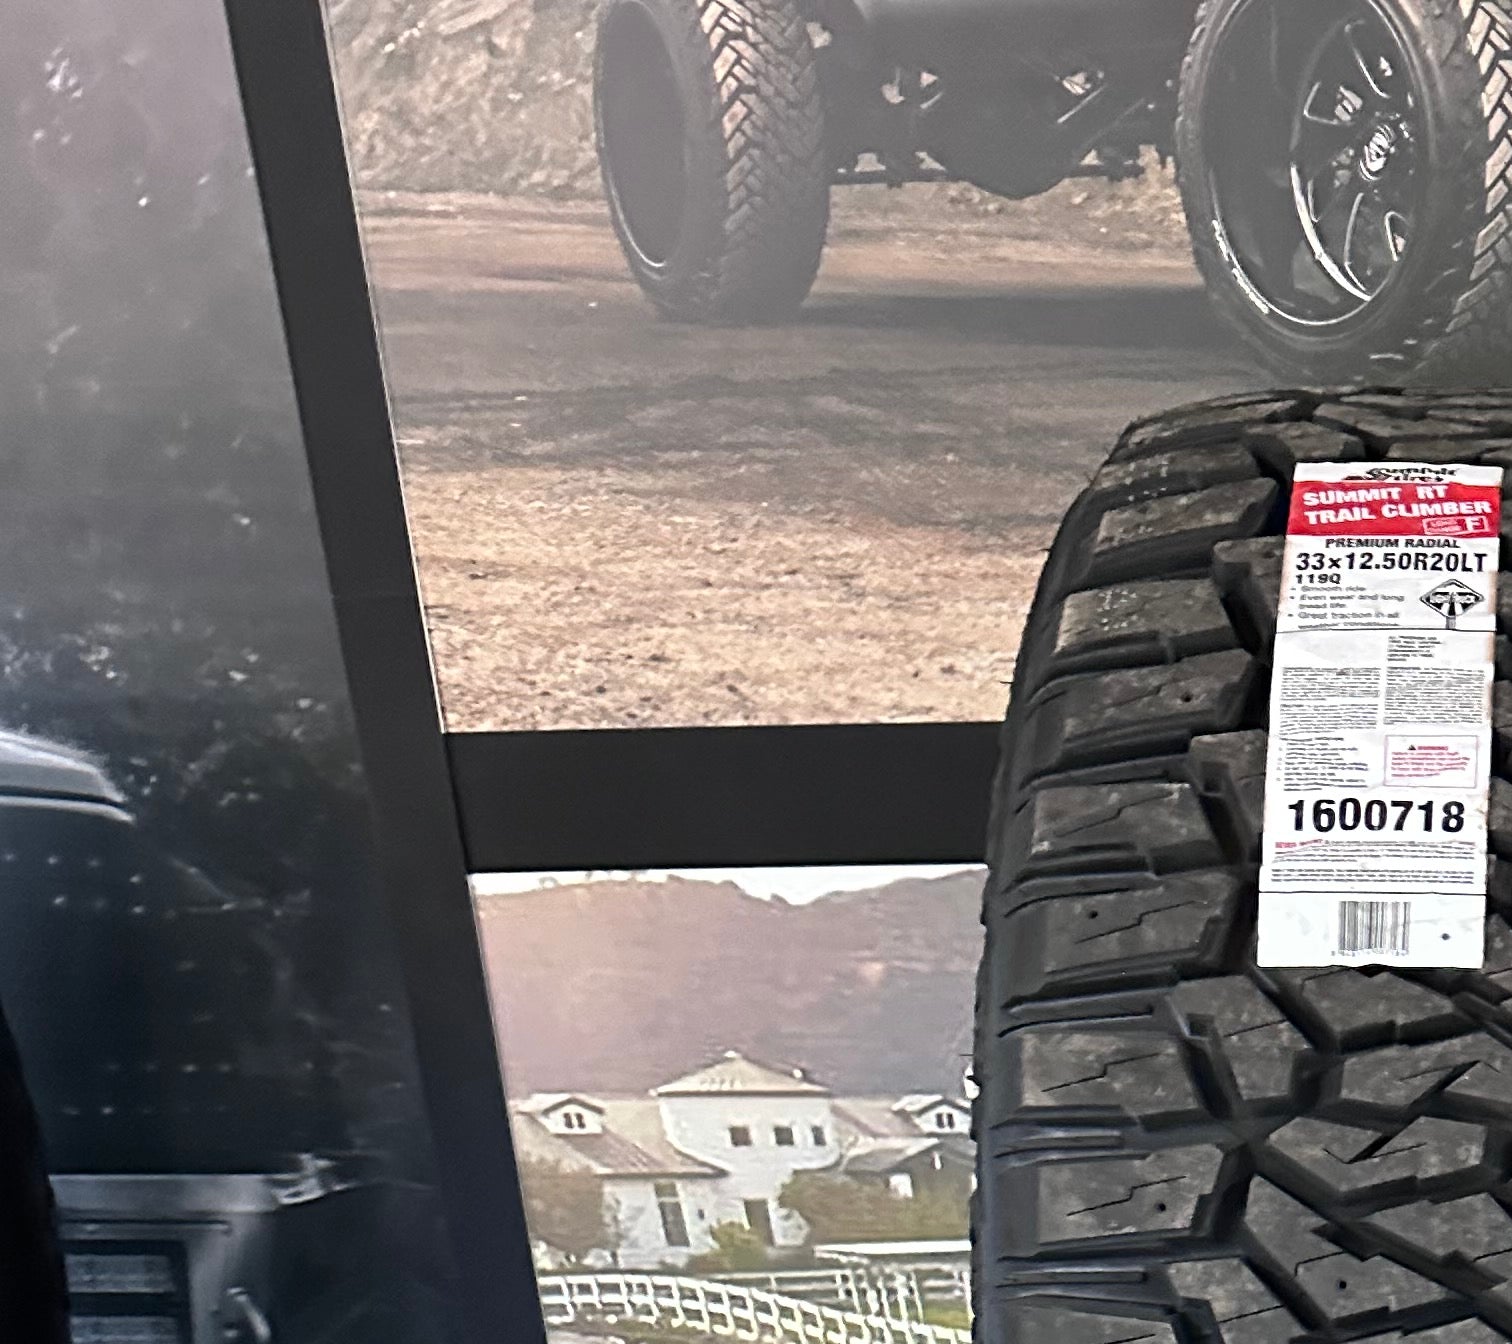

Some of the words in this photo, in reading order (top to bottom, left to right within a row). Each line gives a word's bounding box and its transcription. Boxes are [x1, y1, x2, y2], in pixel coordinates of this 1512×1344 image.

[1303, 487, 1402, 506] SUMMIT
[1416, 485, 1449, 499] RT
[1304, 508, 1376, 525] TRAIL
[1381, 501, 1492, 518] CLIMBER
[1325, 538, 1399, 549] PREMIUM
[1404, 539, 1461, 549] RADIAL
[1296, 552, 1488, 572] 33x12.50R20LT
[1296, 574, 1341, 585] 119Q
[1288, 798, 1465, 833] 1600718
